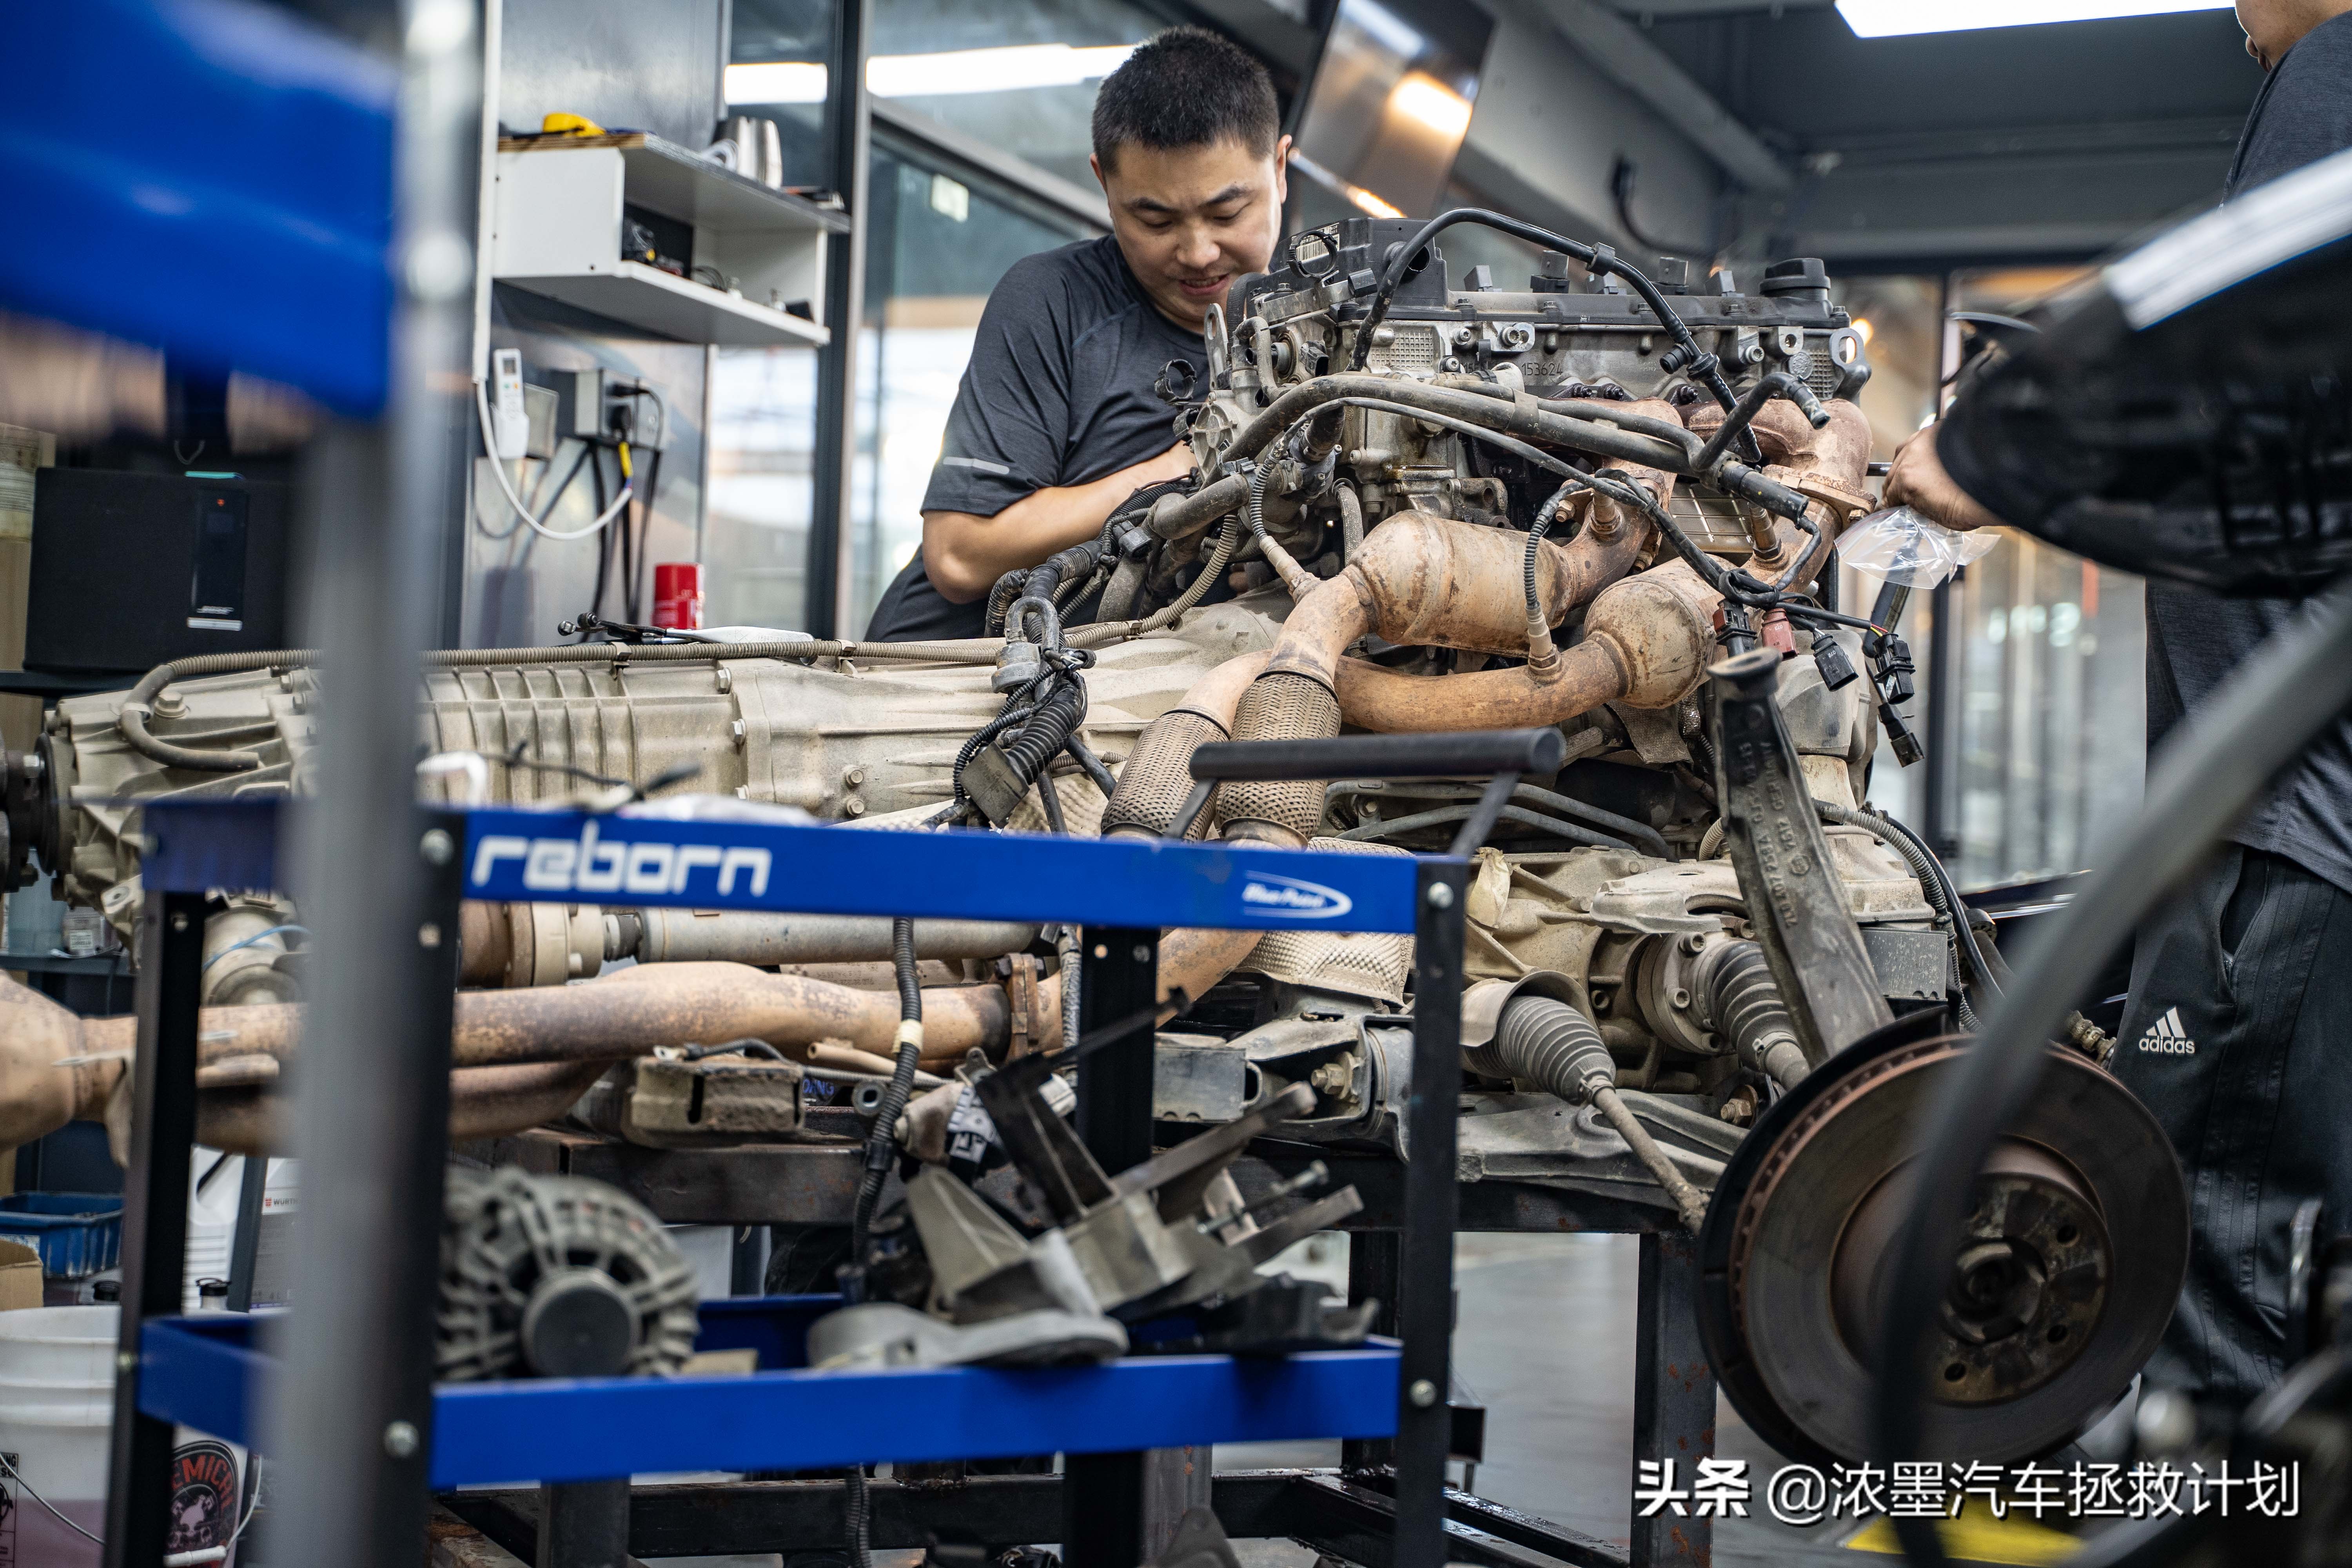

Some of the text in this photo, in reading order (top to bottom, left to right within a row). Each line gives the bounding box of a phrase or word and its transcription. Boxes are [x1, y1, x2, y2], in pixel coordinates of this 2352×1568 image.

[1521, 361, 1563, 376] 153624
[470, 818, 773, 898] reborn
[2138, 1036, 2195, 1054] adidas
